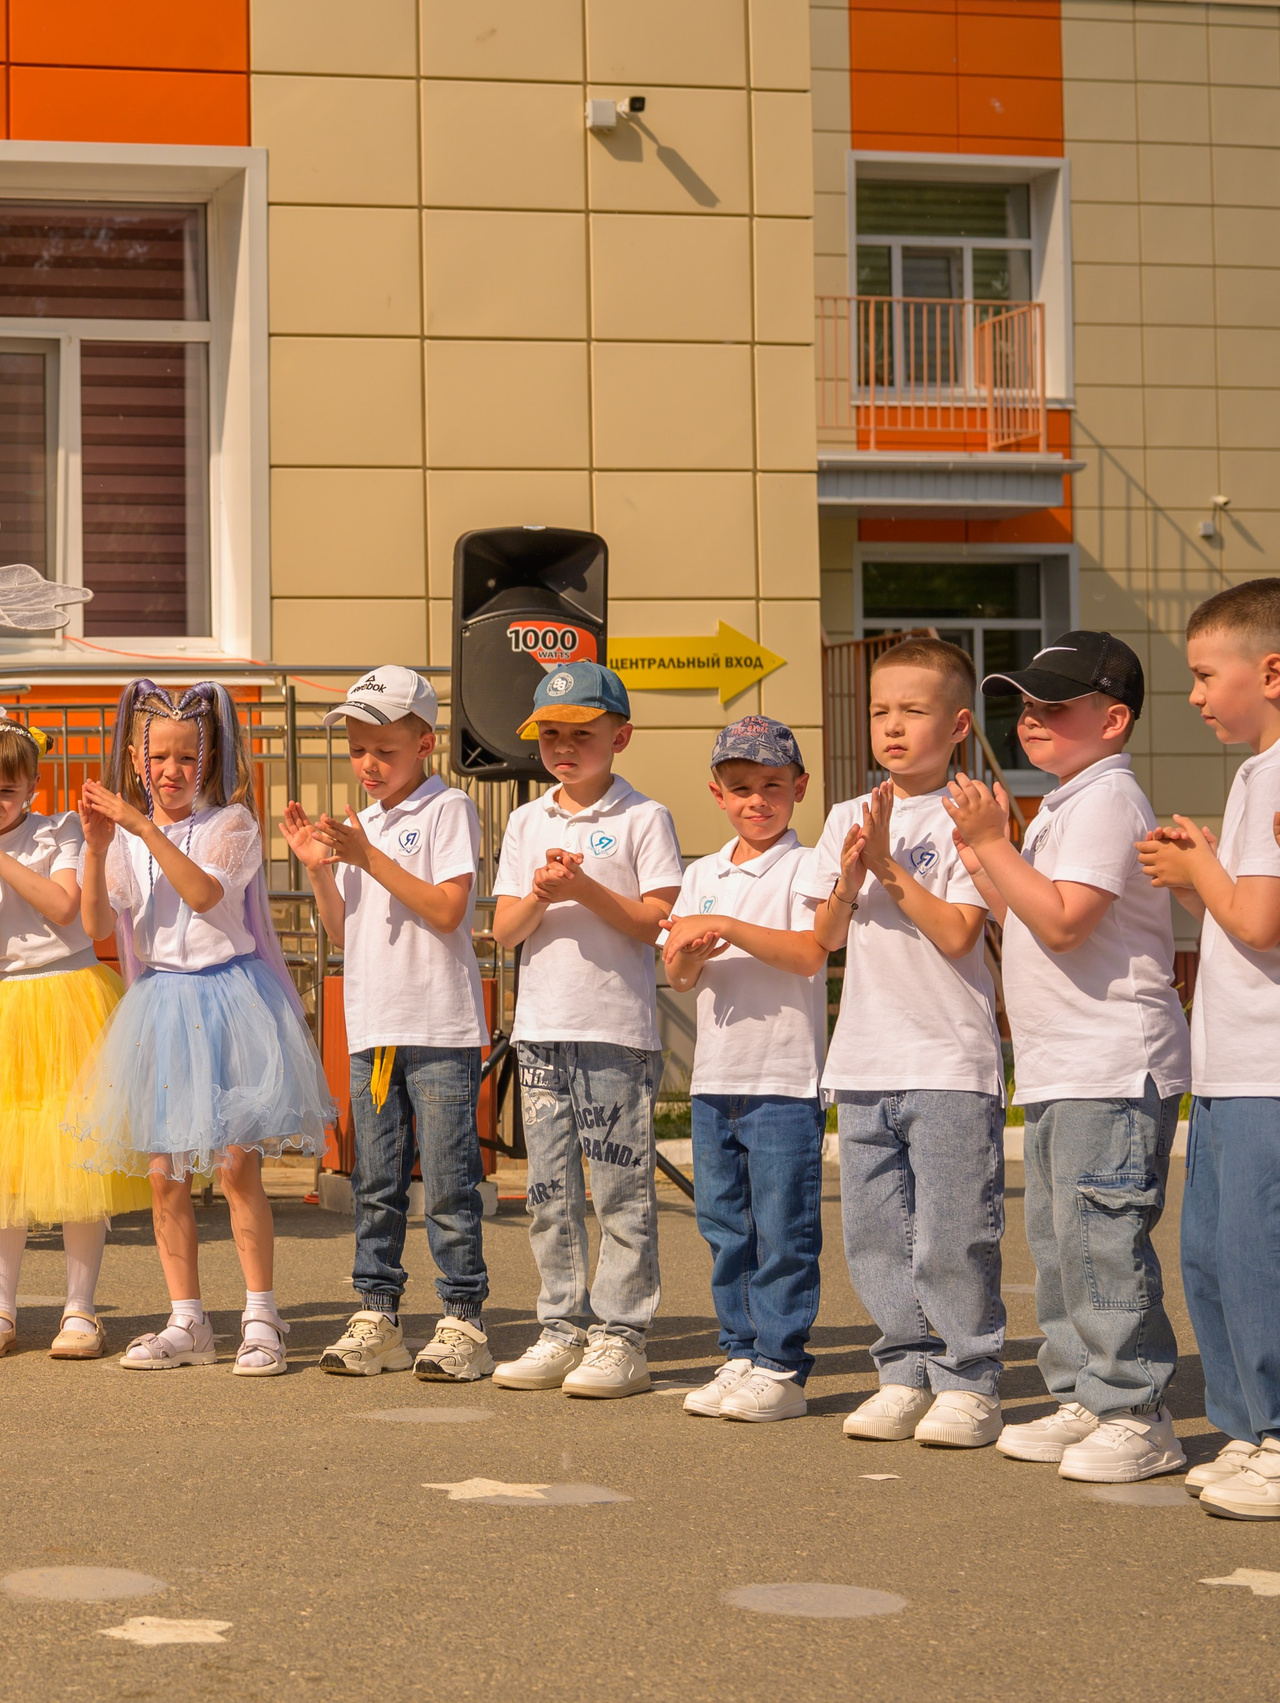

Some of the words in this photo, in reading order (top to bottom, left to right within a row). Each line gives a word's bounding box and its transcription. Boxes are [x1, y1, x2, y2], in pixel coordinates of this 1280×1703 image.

[507, 627, 578, 651] 1000
[538, 651, 570, 659] WATTS
[609, 653, 721, 671] ЦЕНТРАЛЬНЫЙ
[725, 656, 764, 669] ВХОД
[575, 1106, 607, 1130] OCK
[583, 1136, 633, 1167] BAND
